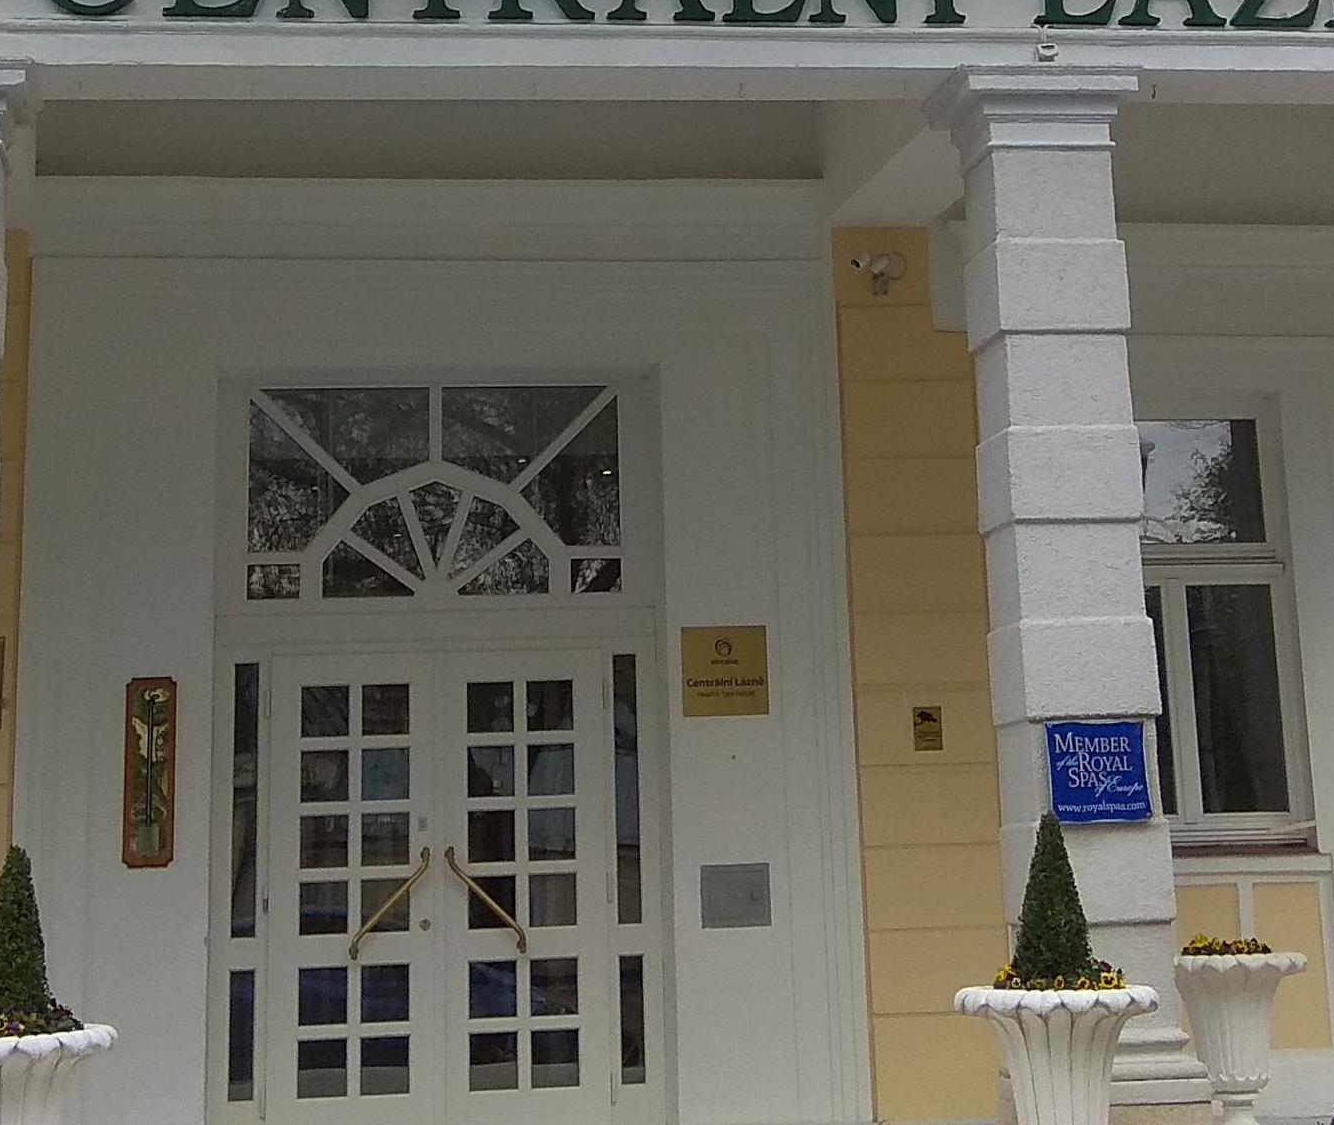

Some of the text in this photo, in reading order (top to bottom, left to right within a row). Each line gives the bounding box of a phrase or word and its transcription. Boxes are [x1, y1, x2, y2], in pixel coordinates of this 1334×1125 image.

[1054, 732, 1131, 753] MEMBER
[1078, 752, 1133, 772] ROYAL
[1068, 767, 1107, 787] SPAS
[1107, 775, 1144, 796] Europe
[1058, 800, 1146, 814] www.royalspas.com
